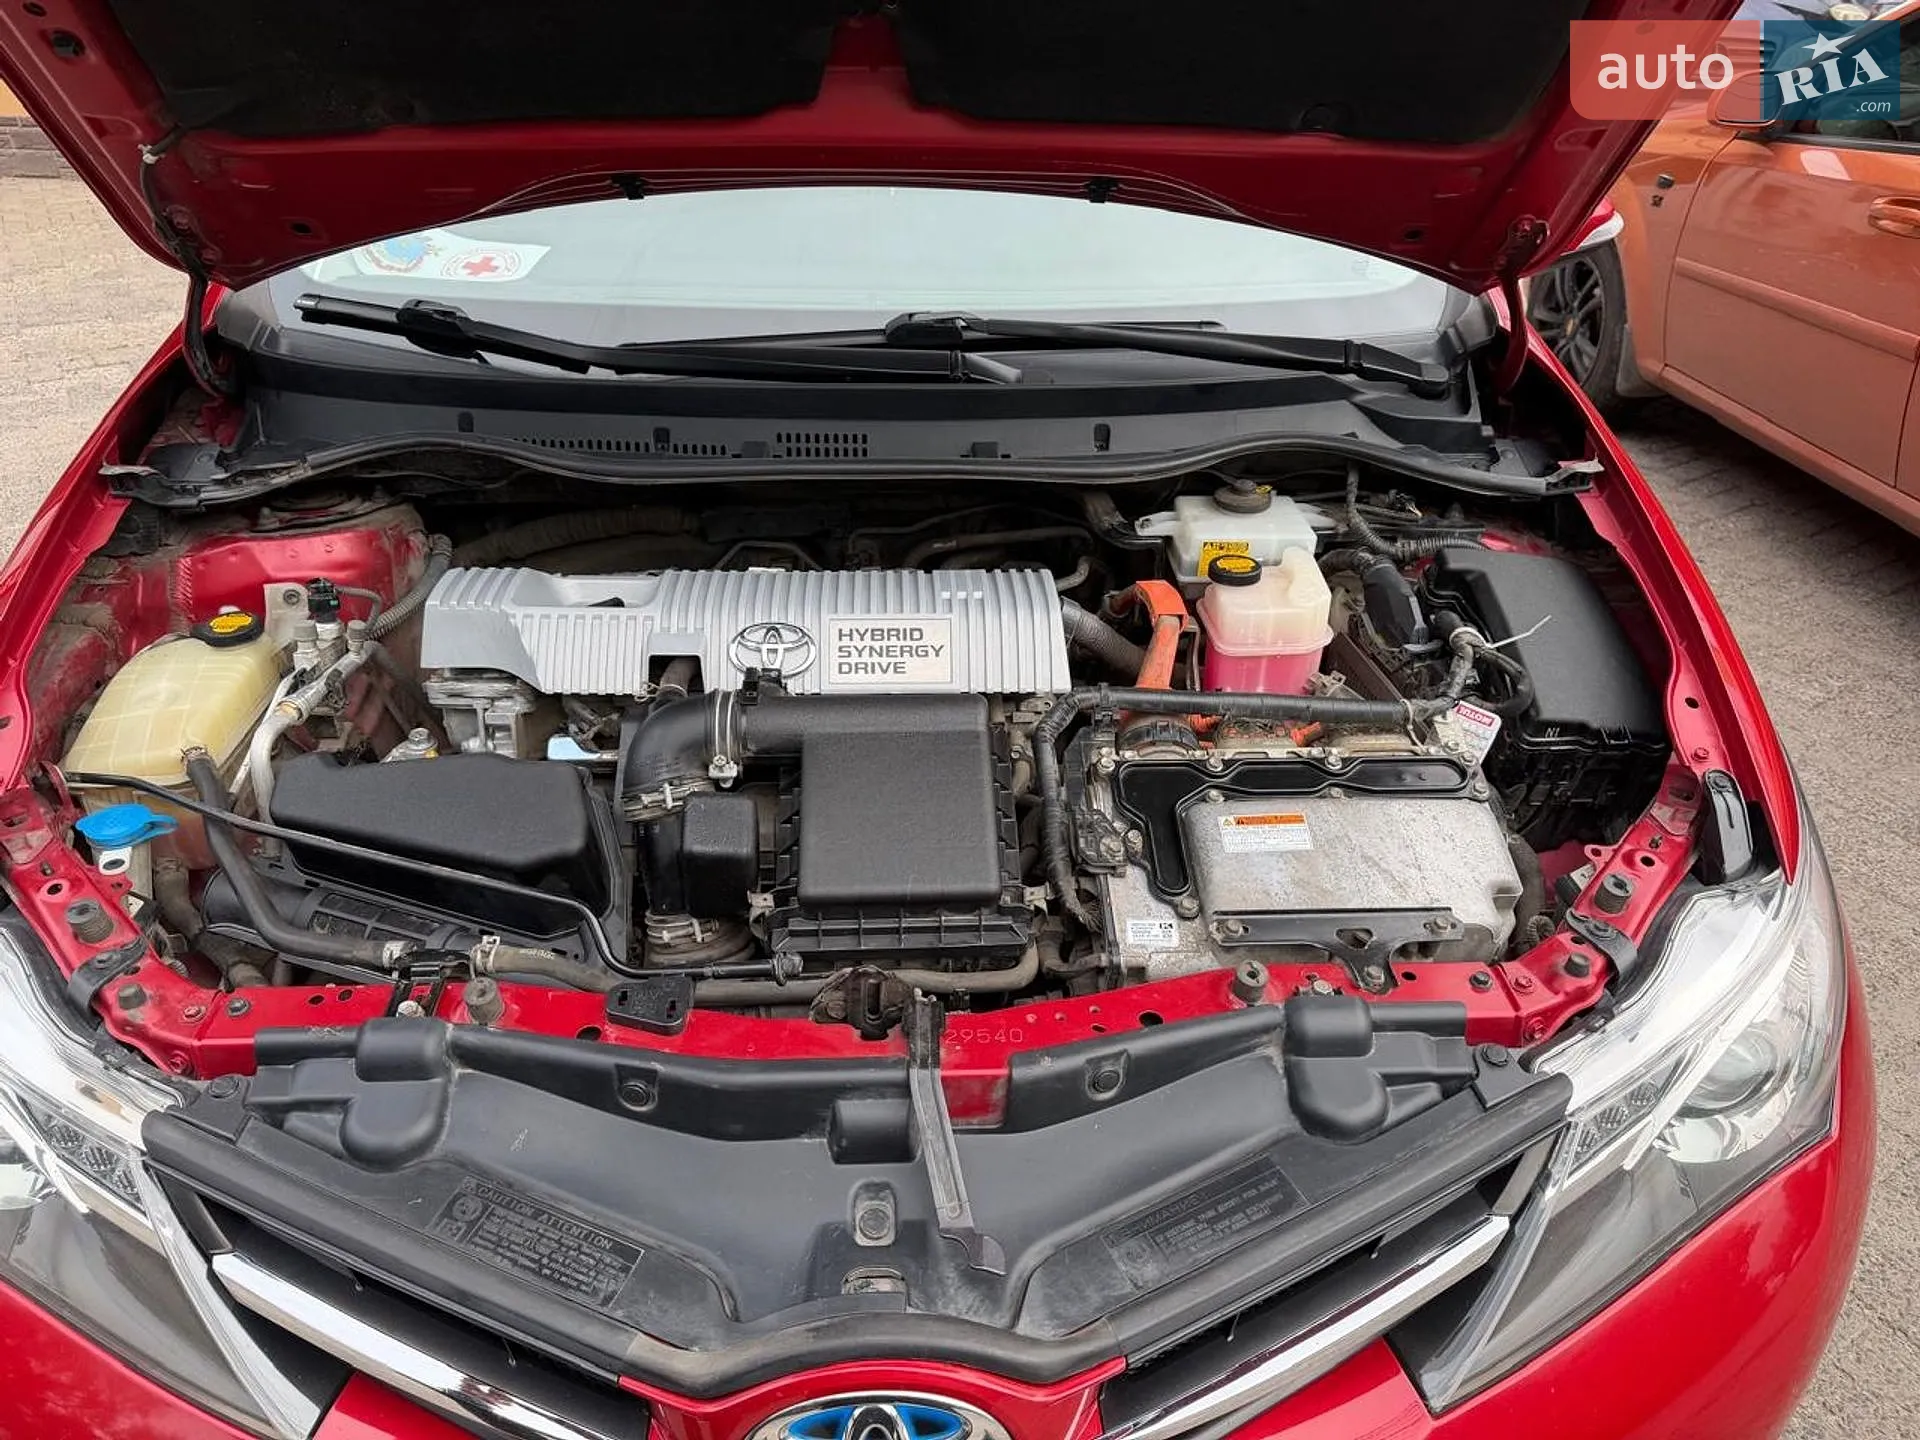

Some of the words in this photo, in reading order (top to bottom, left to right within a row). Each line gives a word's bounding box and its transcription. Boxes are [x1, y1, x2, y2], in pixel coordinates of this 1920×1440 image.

[838, 627, 924, 642] HYBRID
[837, 644, 945, 658] SYNERGY
[838, 661, 907, 675] DRIVE
[944, 1028, 1024, 1045] 29540
[476, 1186, 535, 1219] CAUTION
[538, 1213, 614, 1251] ATTENTION
